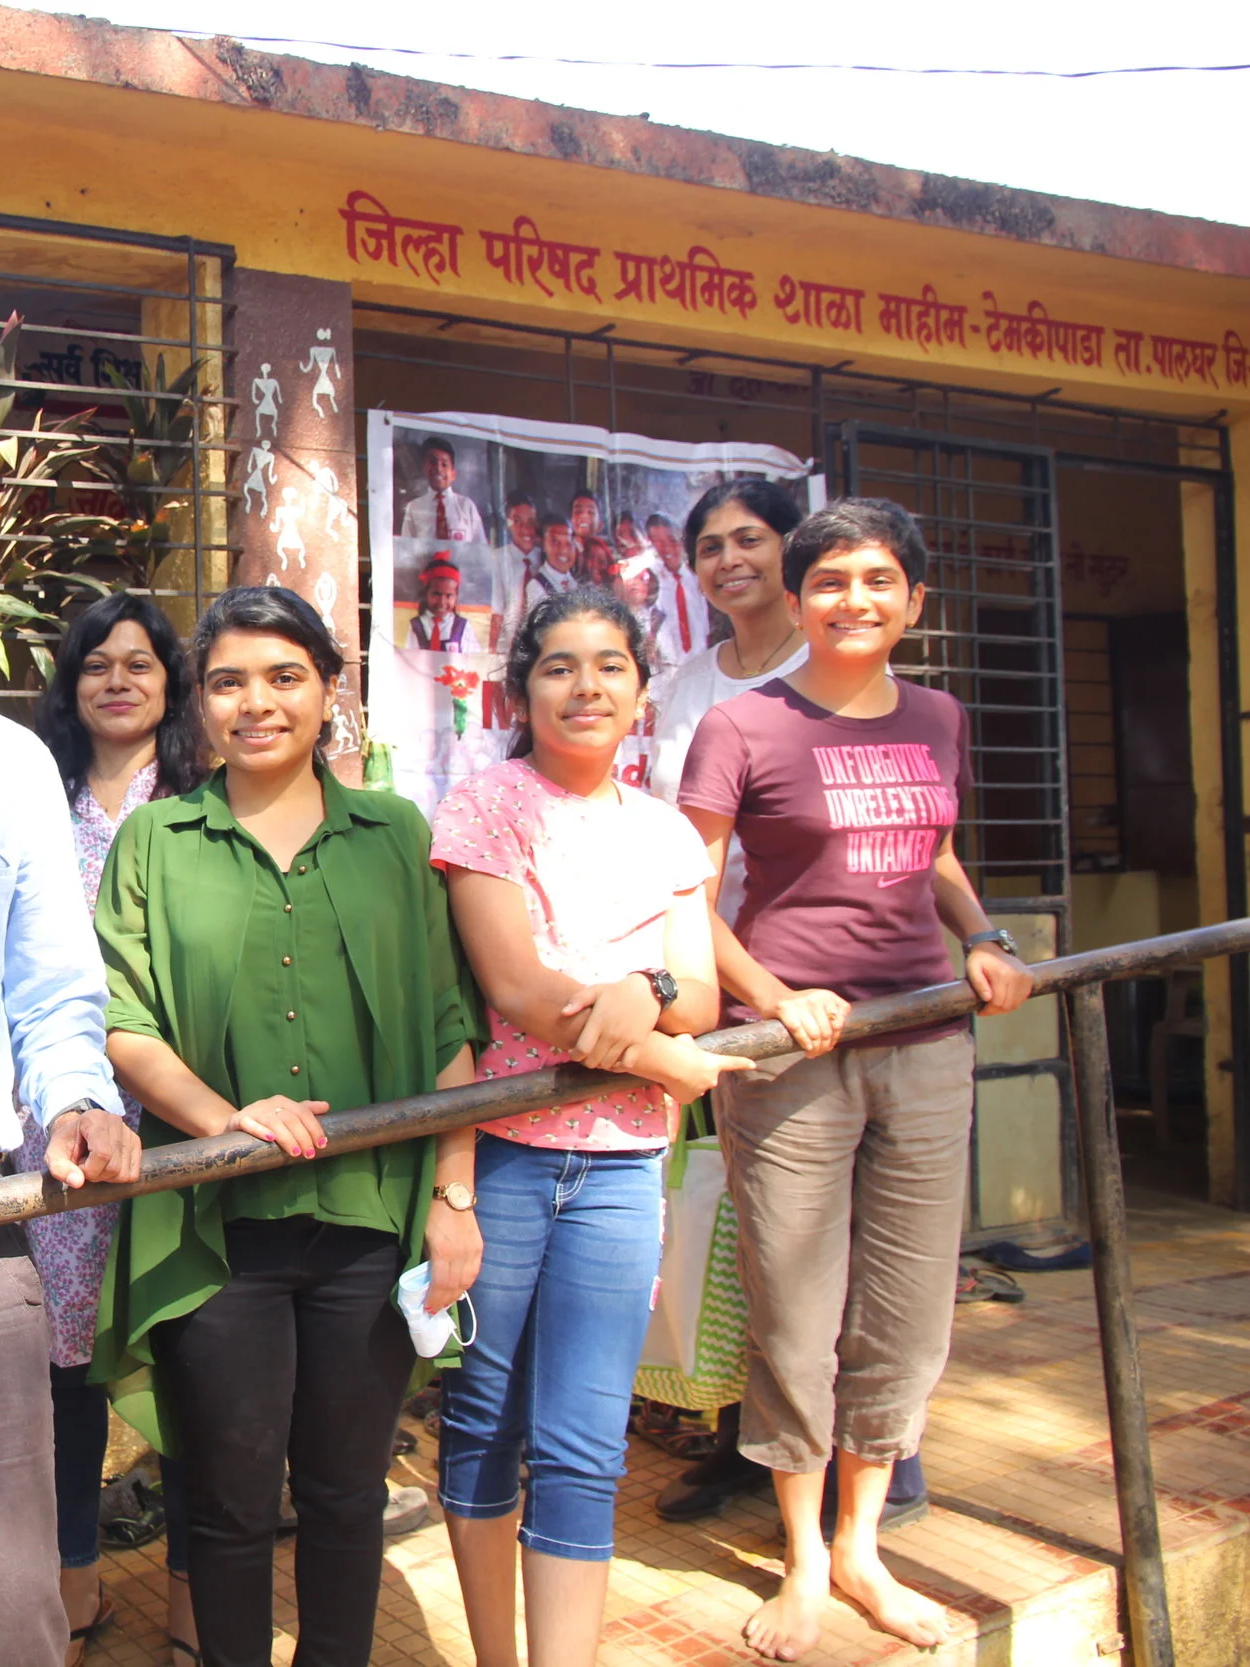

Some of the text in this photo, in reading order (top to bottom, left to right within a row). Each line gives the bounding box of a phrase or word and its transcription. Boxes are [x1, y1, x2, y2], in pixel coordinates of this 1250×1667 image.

[337, 190, 465, 286] जिल्हा
[478, 215, 603, 305] परिषद
[613, 245, 758, 321] प्राथमिक
[773, 273, 866, 335] शाळा
[812, 743, 942, 785] UNFORGIVING
[823, 785, 956, 829] UNRELENTING
[846, 829, 937, 873] UNTAMED
